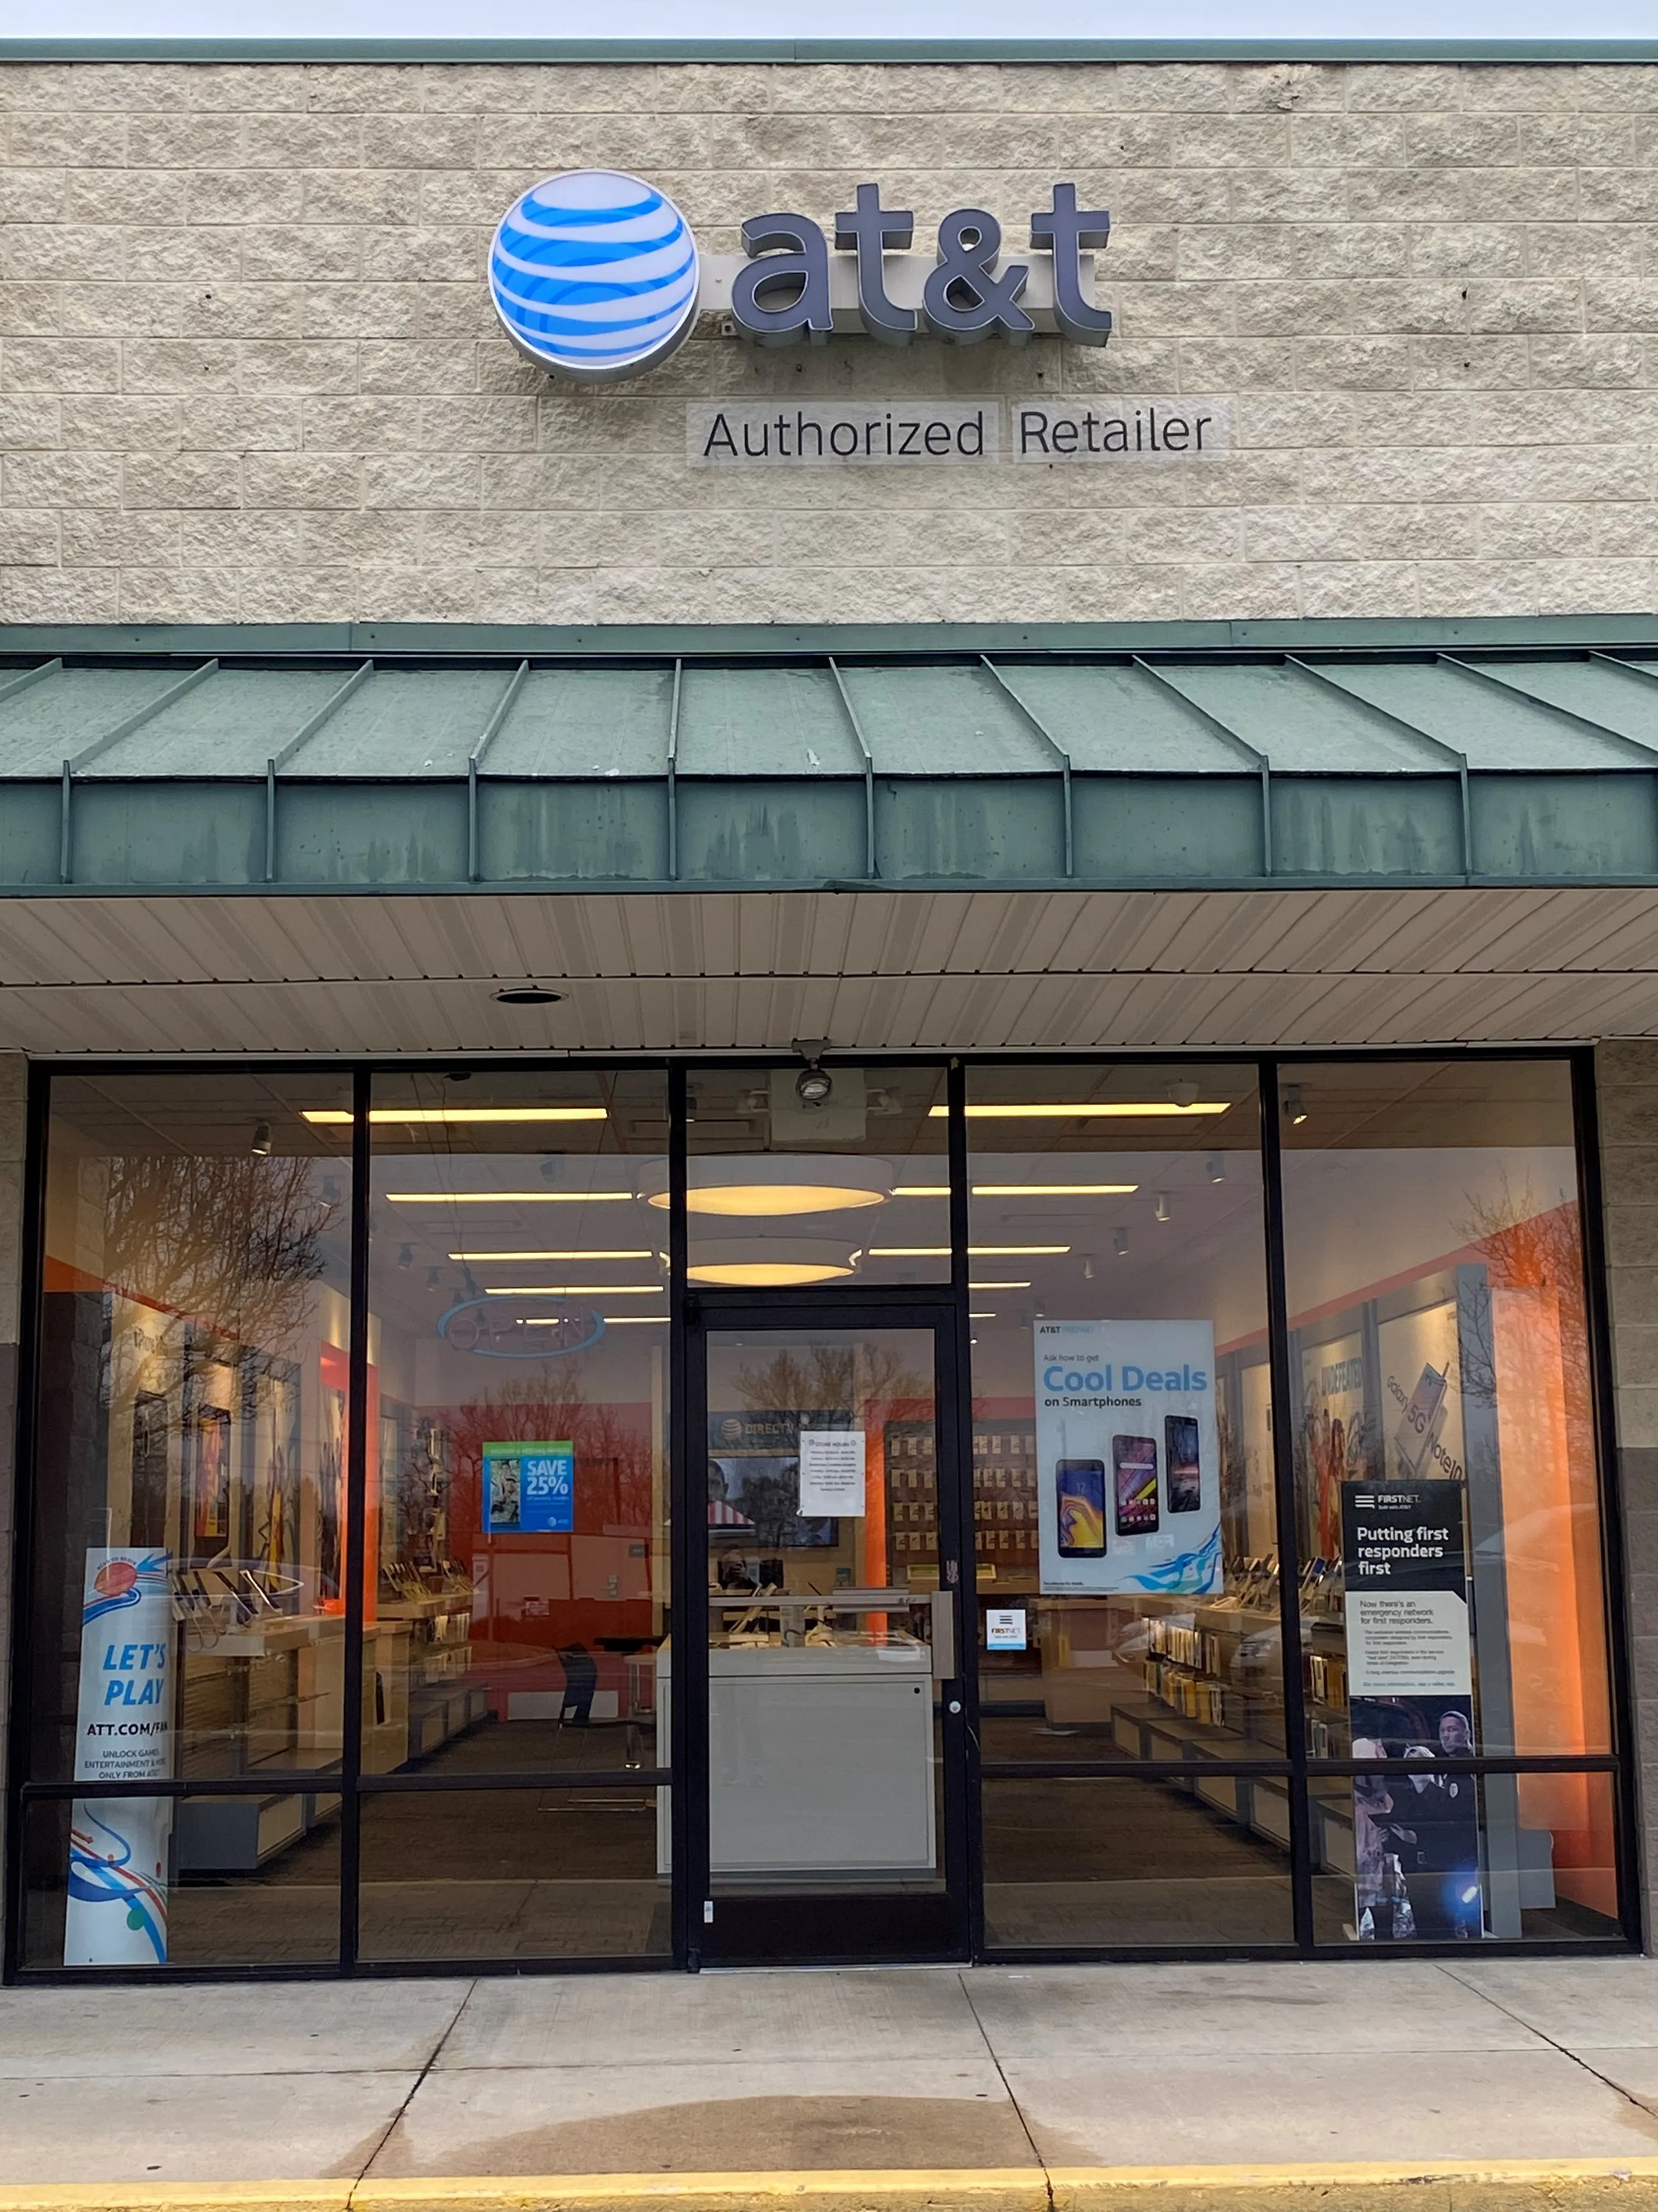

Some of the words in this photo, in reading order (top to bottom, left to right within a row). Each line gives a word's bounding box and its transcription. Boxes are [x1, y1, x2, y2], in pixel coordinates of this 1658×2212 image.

[731, 183, 1112, 345] at&t
[704, 411, 986, 458] Authorized
[1020, 409, 1212, 454] Retailer
[449, 1305, 585, 1349] OPEN
[1040, 1325, 1061, 1334] AT&T
[1086, 1355, 1100, 1363] get
[1043, 1364, 1112, 1392] Cool
[1122, 1364, 1207, 1392] Deals
[1044, 1398, 1060, 1407] on
[1062, 1396, 1142, 1409] Smartphones
[1387, 1375, 1408, 1414] Galaxy
[1407, 1404, 1427, 1434] 5G
[527, 1459, 568, 1476] SAVE
[527, 1476, 569, 1495] 25%
[1357, 1526, 1413, 1543] Putting
[1416, 1526, 1449, 1541] first
[1357, 1543, 1444, 1560] responders
[1358, 1561, 1391, 1575] first
[103, 1643, 167, 1671] LET'S
[104, 1678, 165, 1706] PLAY
[103, 1750, 137, 1758] UNLOCK
[84, 1759, 150, 1769] ENTERTAINMENT
[99, 1771, 122, 1779] ONLY
[122, 1770, 145, 1779] FROM
